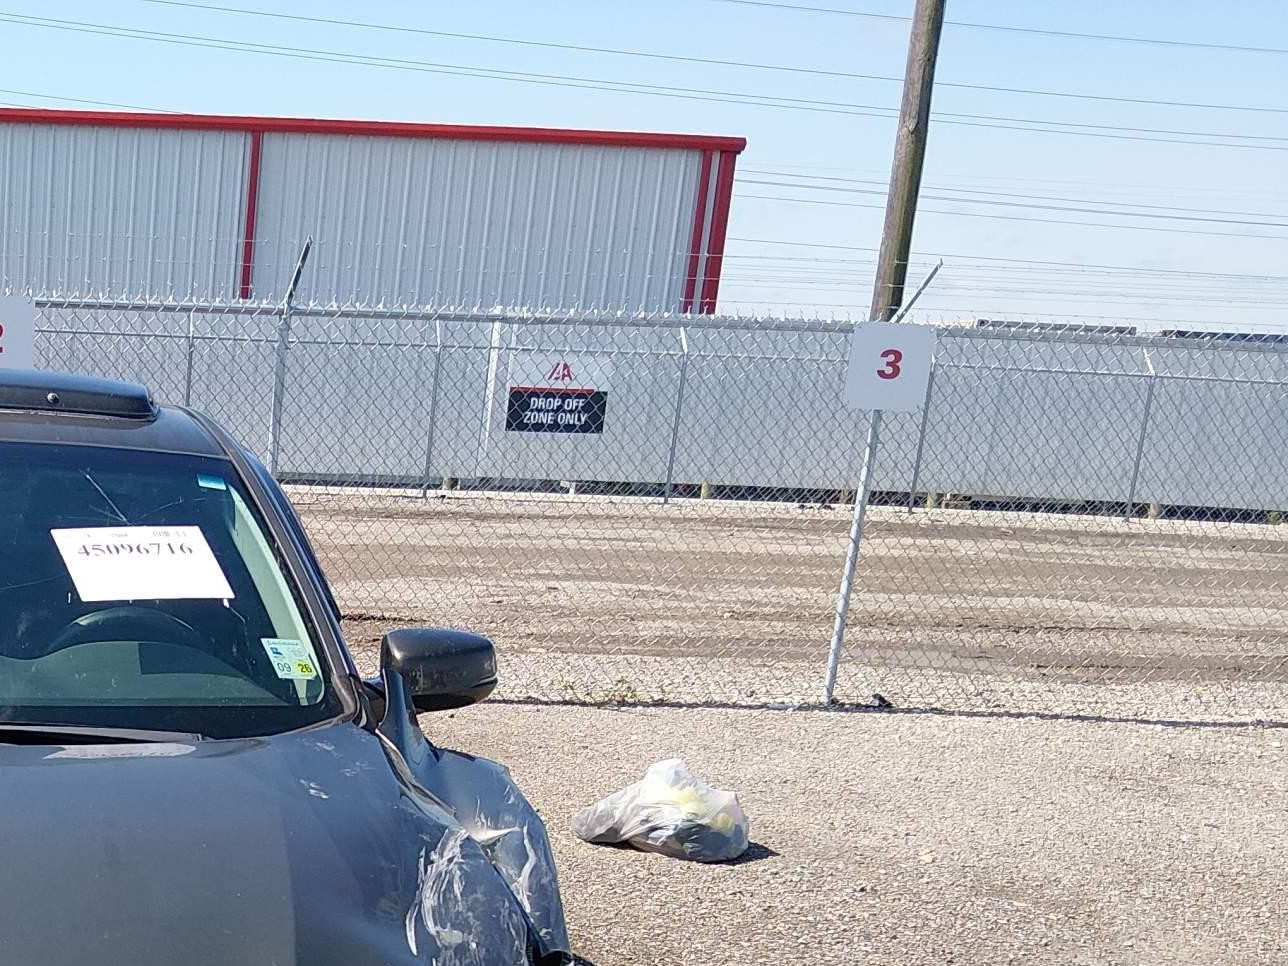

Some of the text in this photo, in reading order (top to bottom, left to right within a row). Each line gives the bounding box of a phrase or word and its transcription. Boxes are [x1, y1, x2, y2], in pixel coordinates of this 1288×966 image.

[876, 348, 903, 380] 3
[530, 397, 586, 411] DROP OFF
[523, 411, 588, 425] ZONE ONLY
[77, 542, 194, 557] 45096716
[277, 662, 313, 673] 09 26
